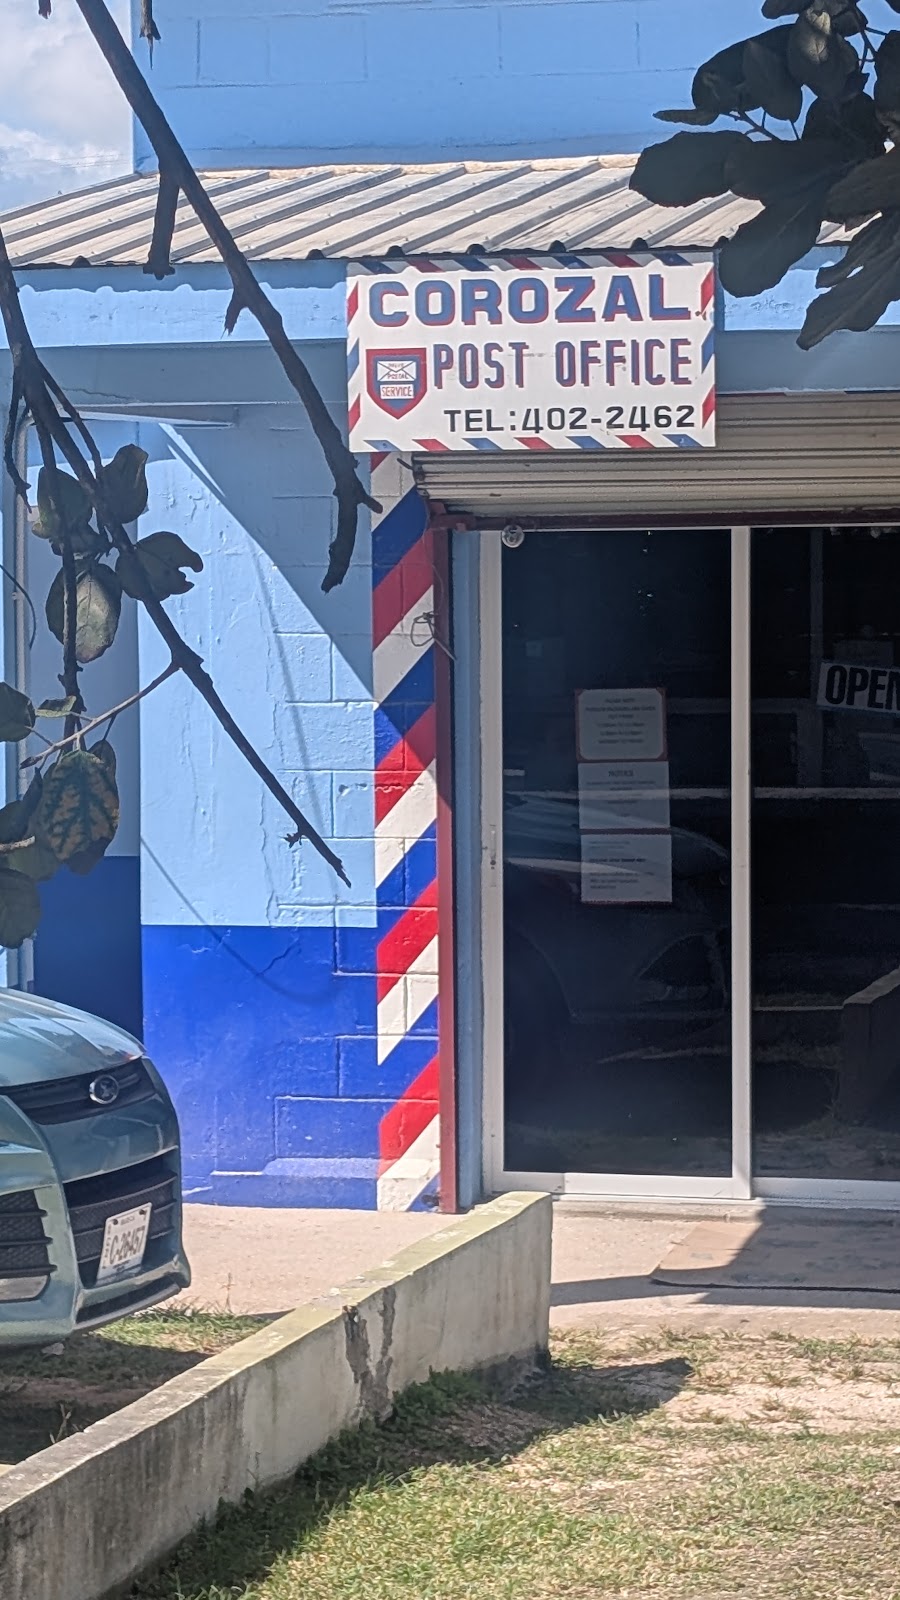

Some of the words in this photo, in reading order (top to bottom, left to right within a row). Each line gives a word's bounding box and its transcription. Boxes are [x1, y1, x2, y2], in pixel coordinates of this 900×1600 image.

[369, 274, 691, 327] COROZAL
[432, 342, 529, 389] POST
[555, 338, 692, 387] OFFICE
[381, 386, 413, 397] SERVICE
